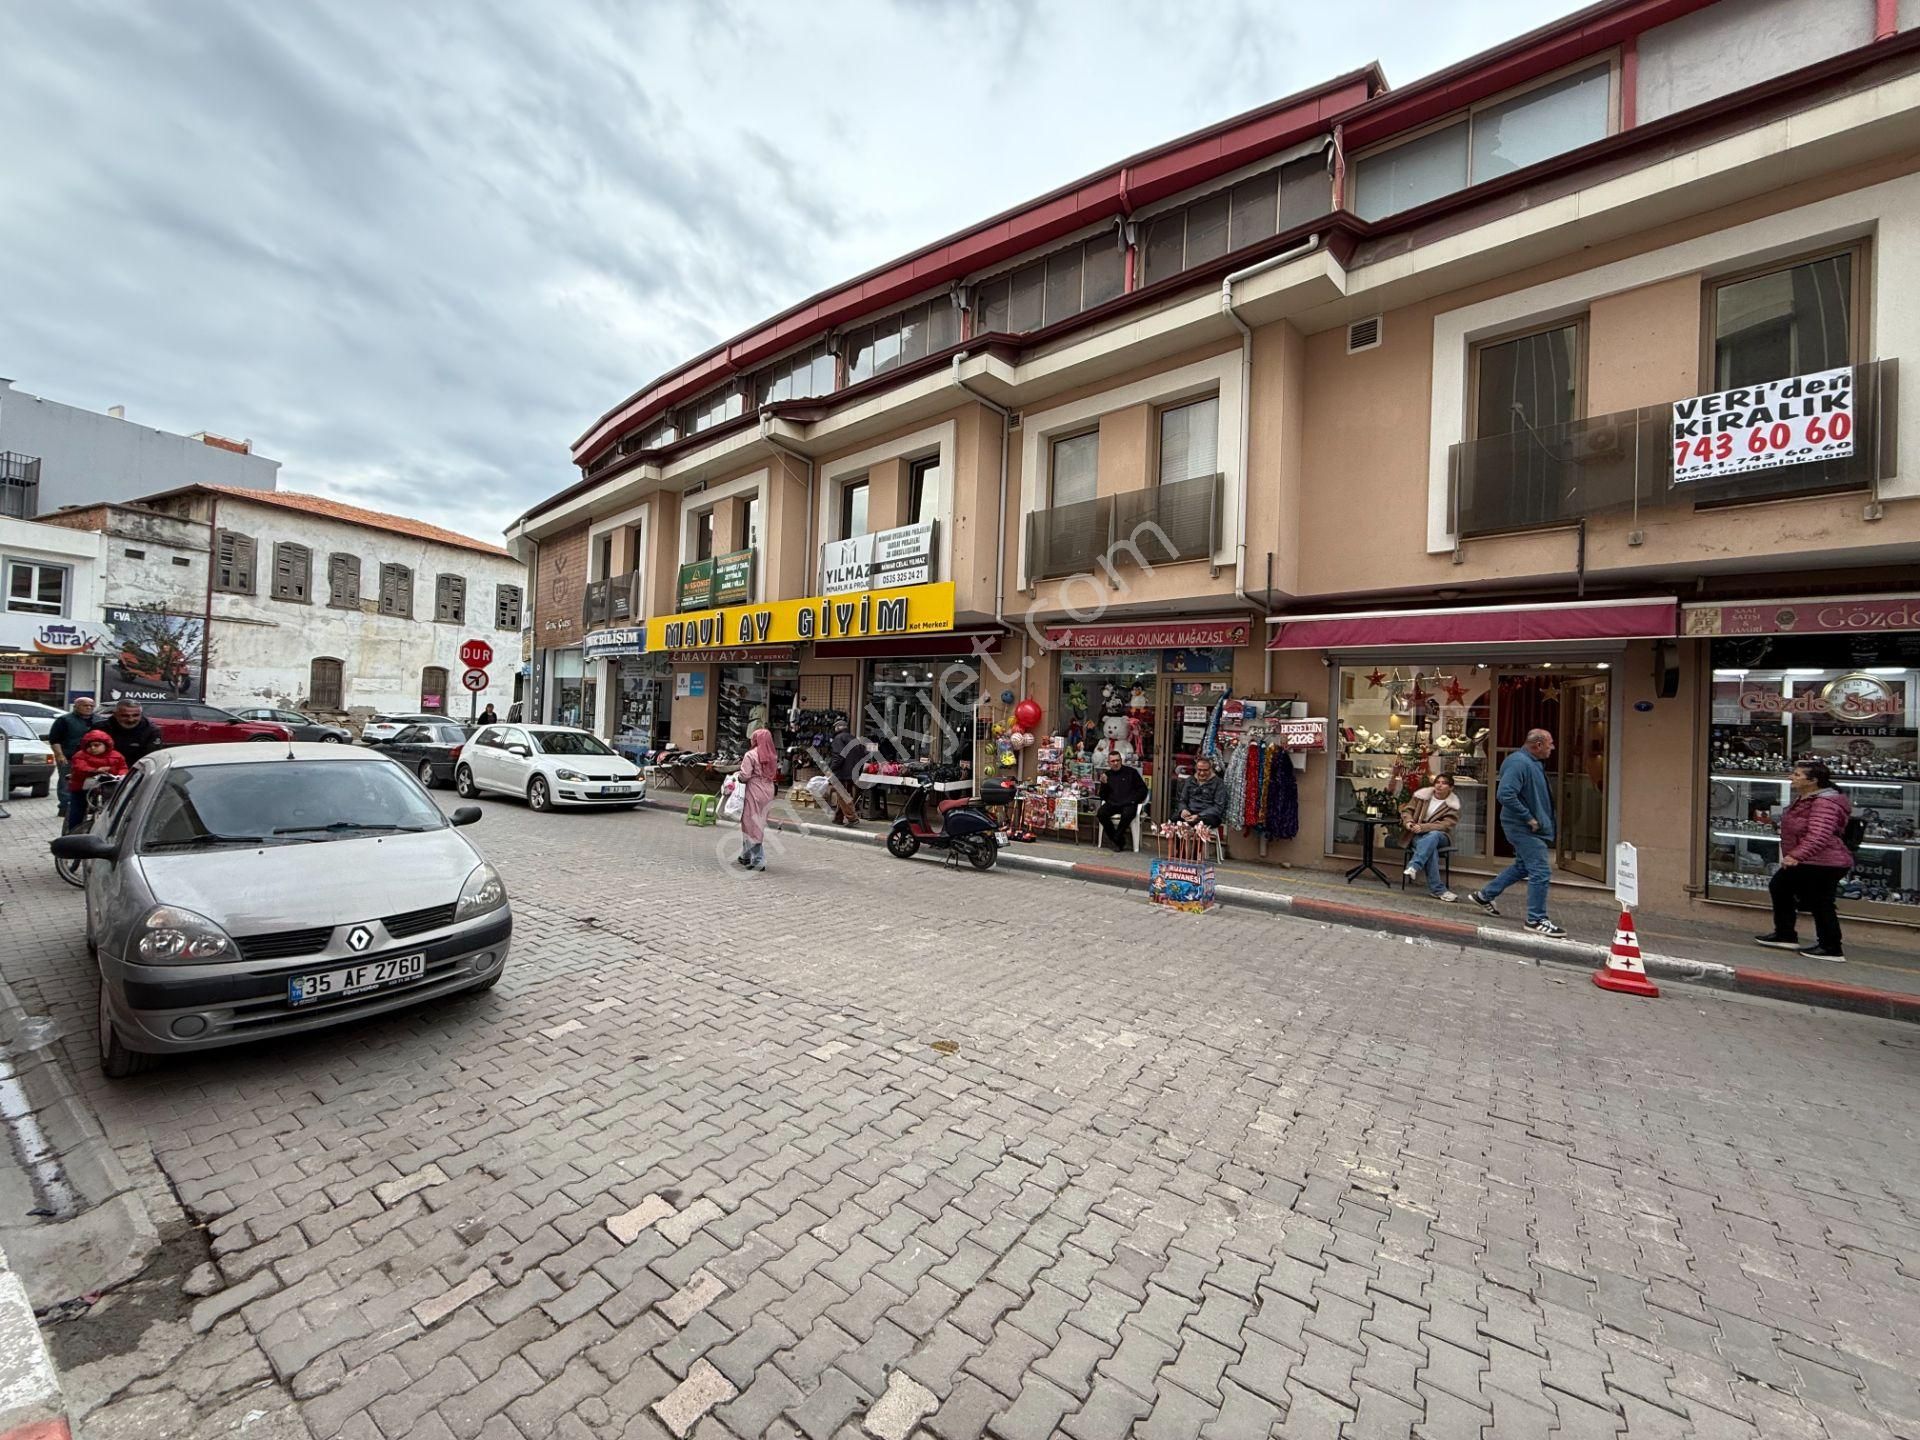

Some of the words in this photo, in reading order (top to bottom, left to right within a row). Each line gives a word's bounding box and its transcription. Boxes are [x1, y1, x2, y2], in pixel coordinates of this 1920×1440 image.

[1675, 432, 1733, 466] 743
[1748, 423, 1791, 454] 60
[1805, 412, 1852, 445] 60
[1785, 447, 1813, 457] 60
[1822, 441, 1852, 452] 60
[826, 563, 871, 584] YILMAZ
[664, 612, 724, 648] MAVİ
[738, 611, 771, 643] AY
[797, 594, 908, 637] GİYİM
[909, 622, 921, 630] Kot
[922, 620, 949, 630] Merkezi
[39, 625, 94, 650] burak
[1101, 634, 1135, 646] AYAKLAR
[1137, 632, 1175, 646] OYUNCAK
[1177, 628, 1224, 645] MAĞAZASI
[462, 648, 491, 662] DUR
[719, 651, 737, 661] AY
[1738, 688, 1833, 714] Gözde
[1843, 691, 1904, 715] Saat
[1287, 733, 1315, 745] 2026
[305, 974, 331, 995] 35
[344, 966, 367, 988] AF
[375, 956, 421, 981] 2760
